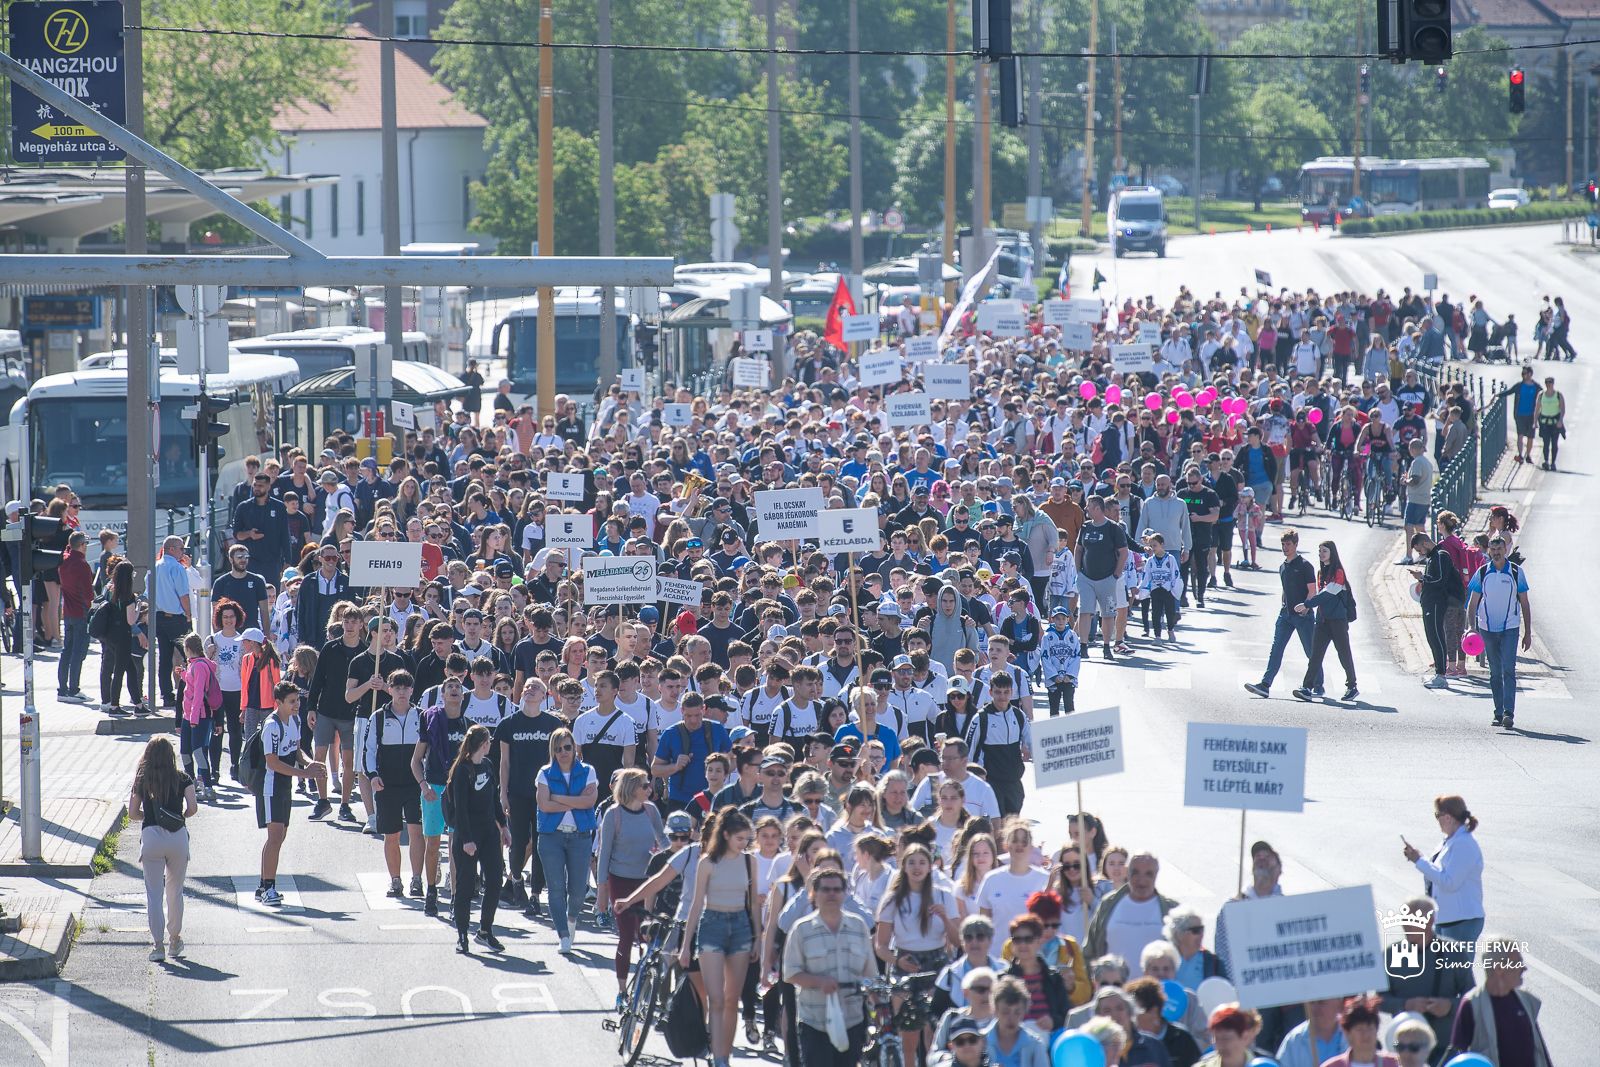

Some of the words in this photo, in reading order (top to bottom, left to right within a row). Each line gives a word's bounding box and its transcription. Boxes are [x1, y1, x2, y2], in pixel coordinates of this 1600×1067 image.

[18, 57, 117, 73] HANGZHOU
[54, 126, 72, 135] 100
[75, 127, 84, 135] m
[20, 141, 77, 155] Megyeház
[80, 142, 105, 152] utca
[108, 141, 119, 151] 3.
[784, 500, 806, 509] OCSKAY
[763, 510, 784, 521] GÁBOR
[785, 509, 818, 520] JÉGKORONG
[777, 520, 808, 530] AKADÉMIA
[824, 537, 874, 546] KÉZILABDA
[368, 560, 403, 569] FEHA19
[589, 586, 615, 594] Megadance
[663, 587, 691, 596] HOCKEY
[664, 581, 697, 591] FEHÉRVÁR
[623, 594, 646, 602] Egyesület
[663, 593, 695, 602] ACADEMY
[1041, 735, 1064, 748] ORKA
[1066, 725, 1114, 742] FEHÉRVÁRI
[1203, 738, 1258, 754] FEHÉRVÁRI
[1260, 741, 1288, 755] SAKK
[1041, 750, 1116, 773] SPORTEGYESÜLET
[1213, 758, 1269, 774] EGYESÜLET
[1203, 779, 1217, 792] TE
[1217, 778, 1252, 794] LÉPTÉL
[1254, 780, 1284, 796] MÁR?
[1276, 914, 1328, 938] NYITOTT
[229, 982, 561, 1024] BUSZ
